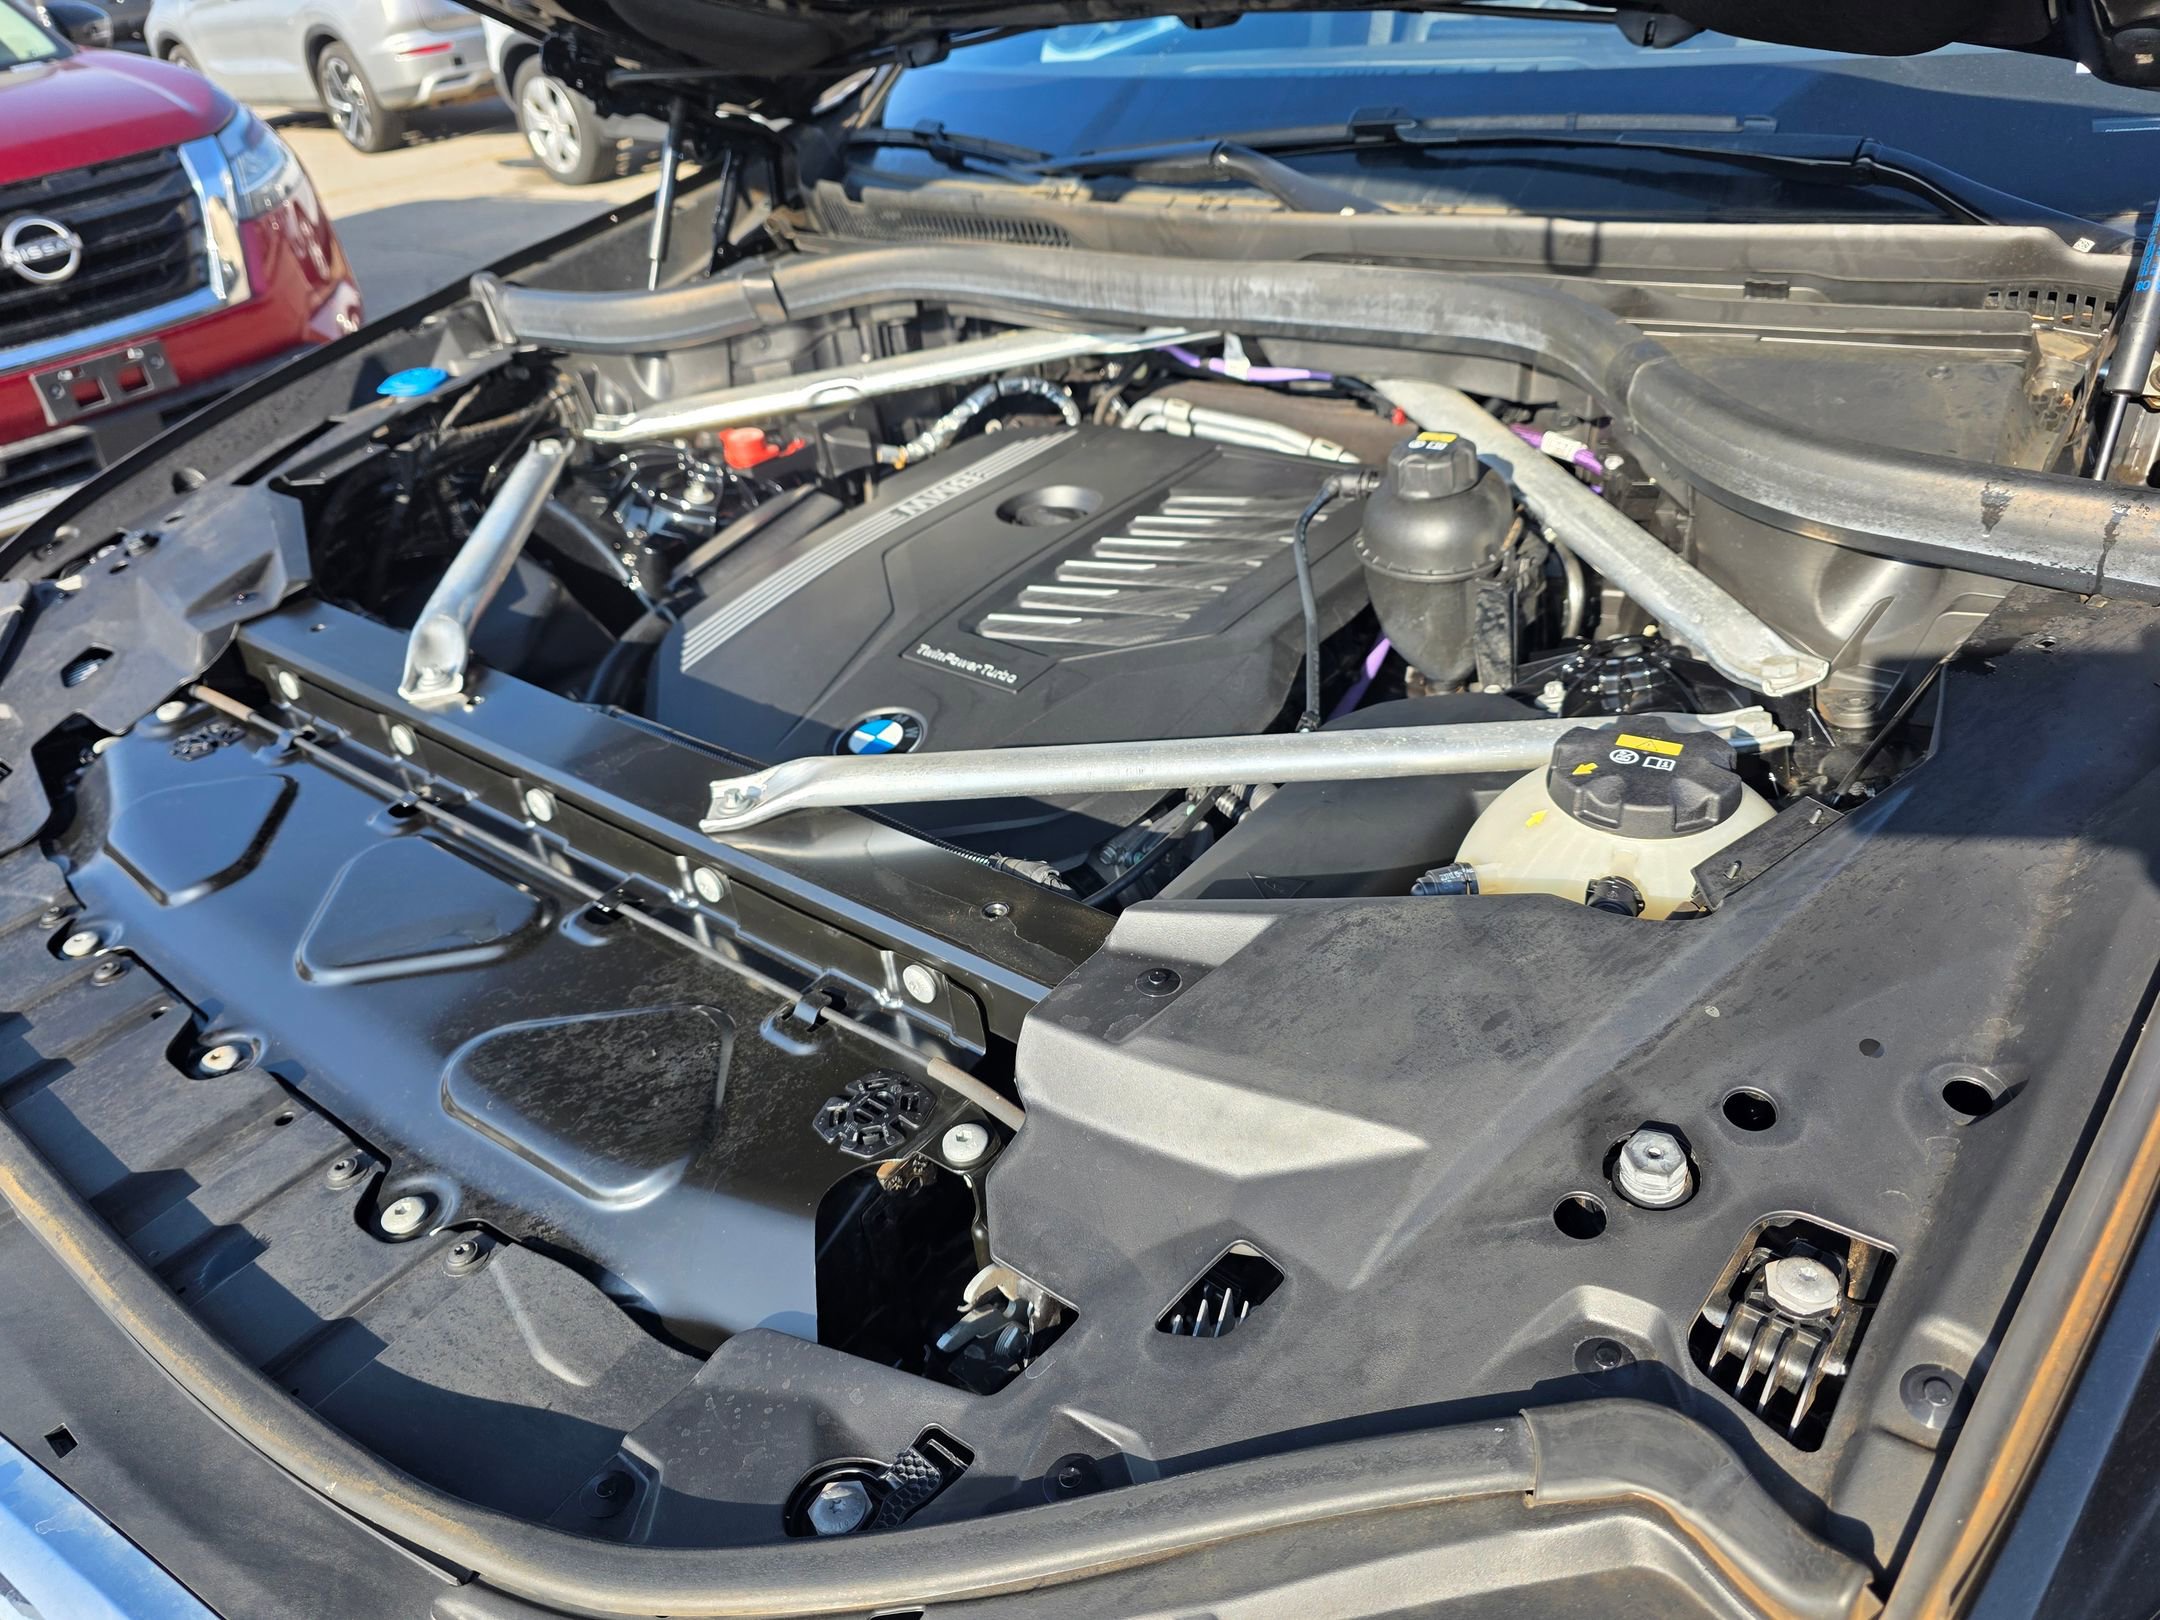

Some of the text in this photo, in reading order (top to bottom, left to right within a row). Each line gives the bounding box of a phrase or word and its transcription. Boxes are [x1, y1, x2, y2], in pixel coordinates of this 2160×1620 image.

[3, 234, 82, 267] NISSAN
[917, 643, 1018, 684] TwinPower Turbo
